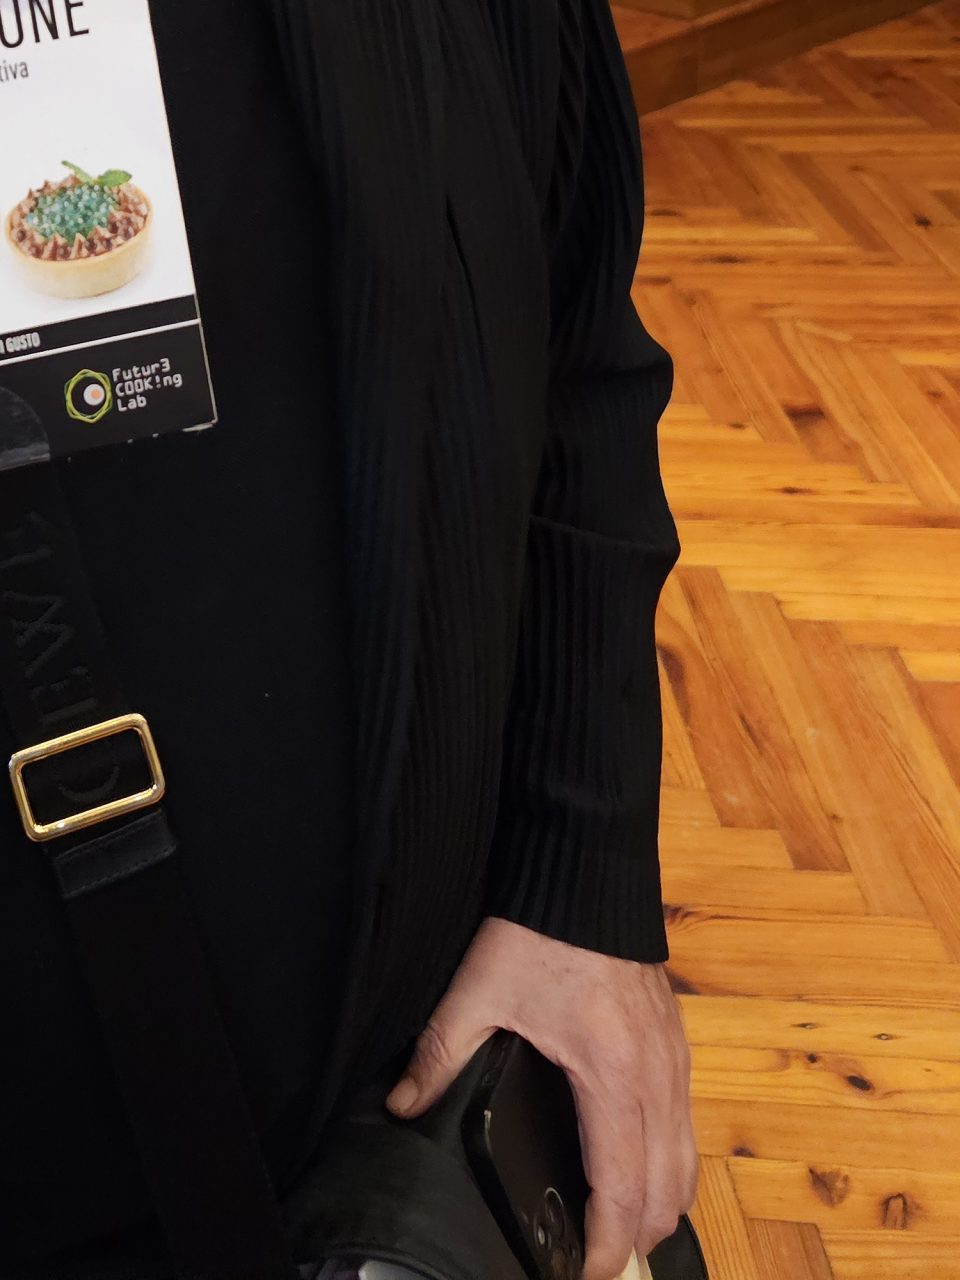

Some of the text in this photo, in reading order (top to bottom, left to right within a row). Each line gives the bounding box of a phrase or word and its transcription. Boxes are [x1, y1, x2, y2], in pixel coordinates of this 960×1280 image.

[5, 331, 41, 353] GUSTO
[112, 357, 171, 382] Futur3
[117, 394, 147, 412] Lab
